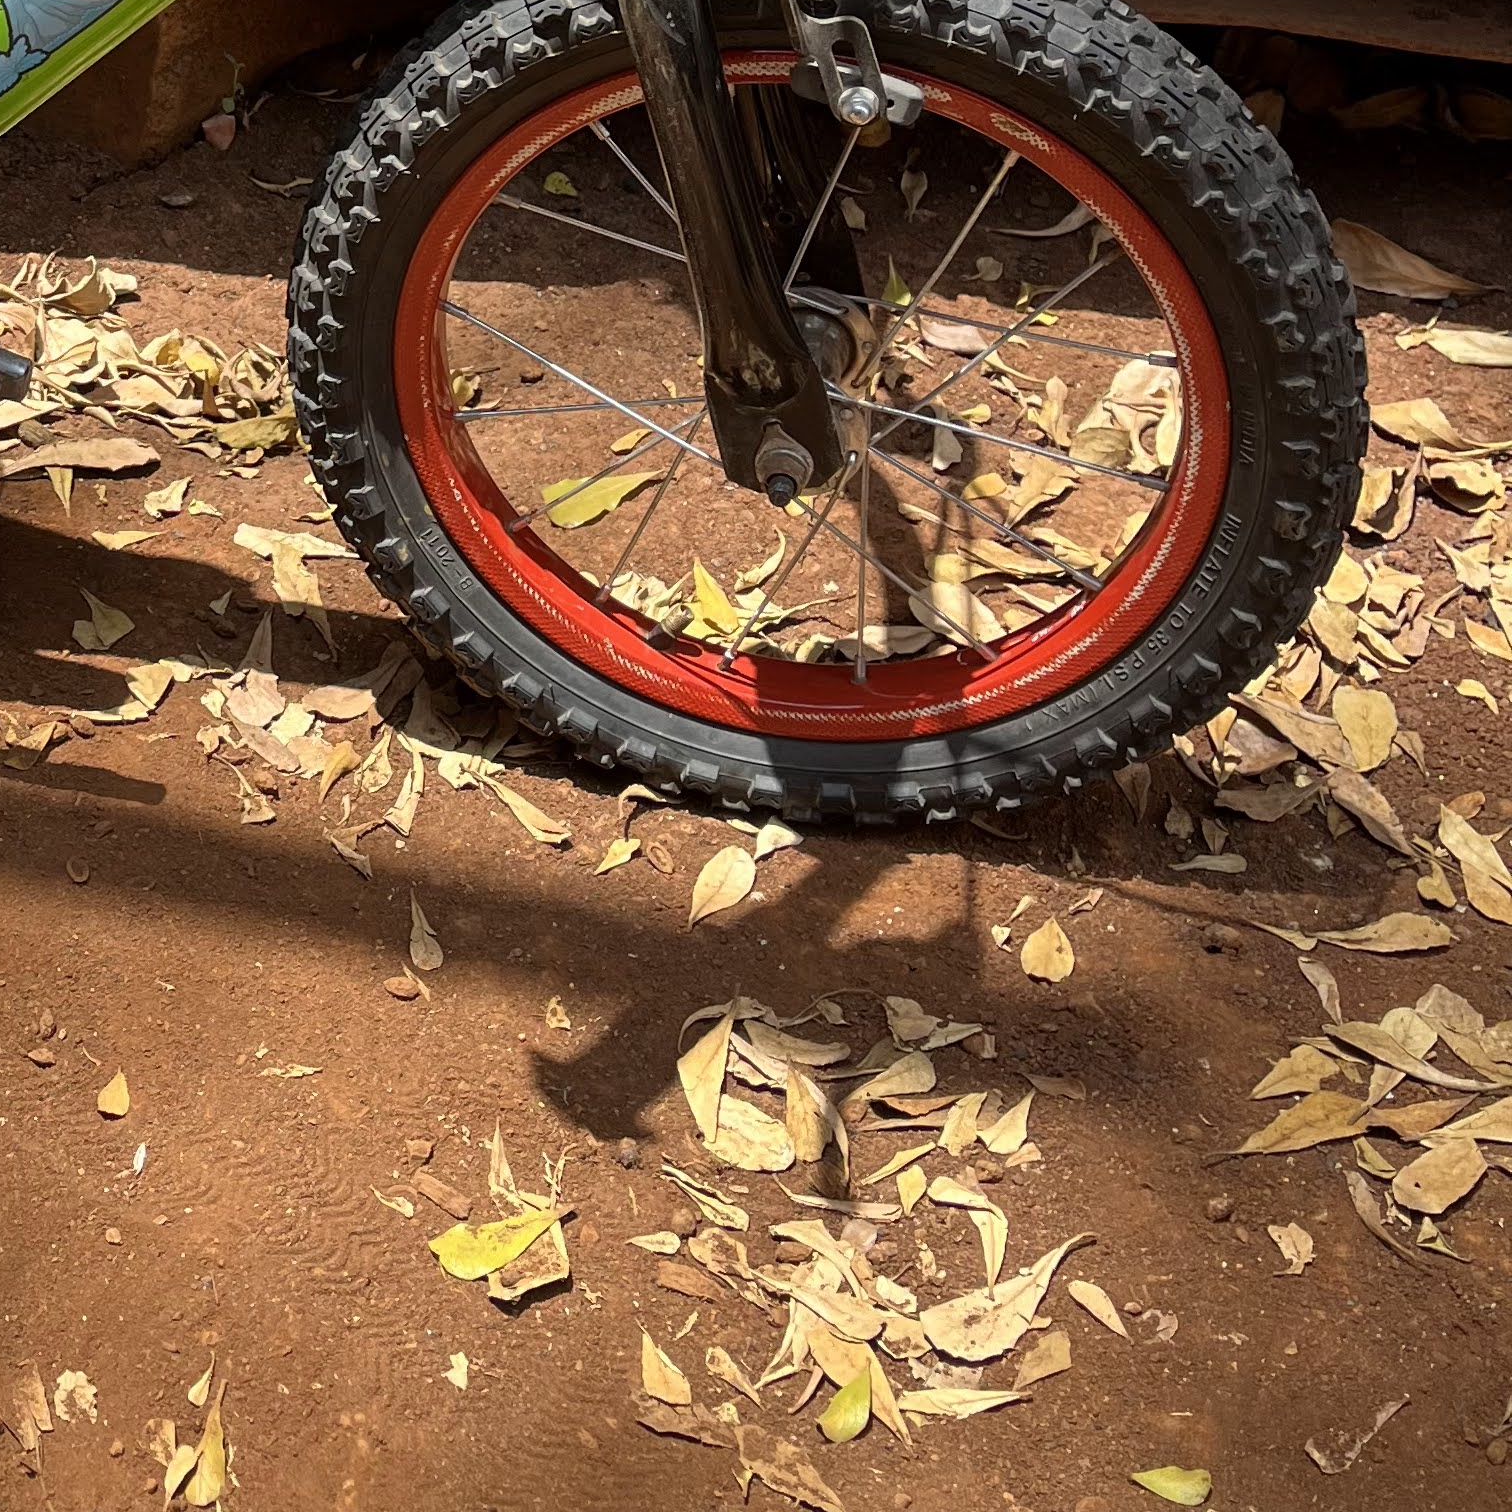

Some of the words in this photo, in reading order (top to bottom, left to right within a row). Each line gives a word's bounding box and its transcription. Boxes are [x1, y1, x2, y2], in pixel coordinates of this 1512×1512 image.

[1190, 512, 1243, 600] INFLATE
[1170, 601, 1196, 630] TO
[1147, 629, 1170, 656] 35
